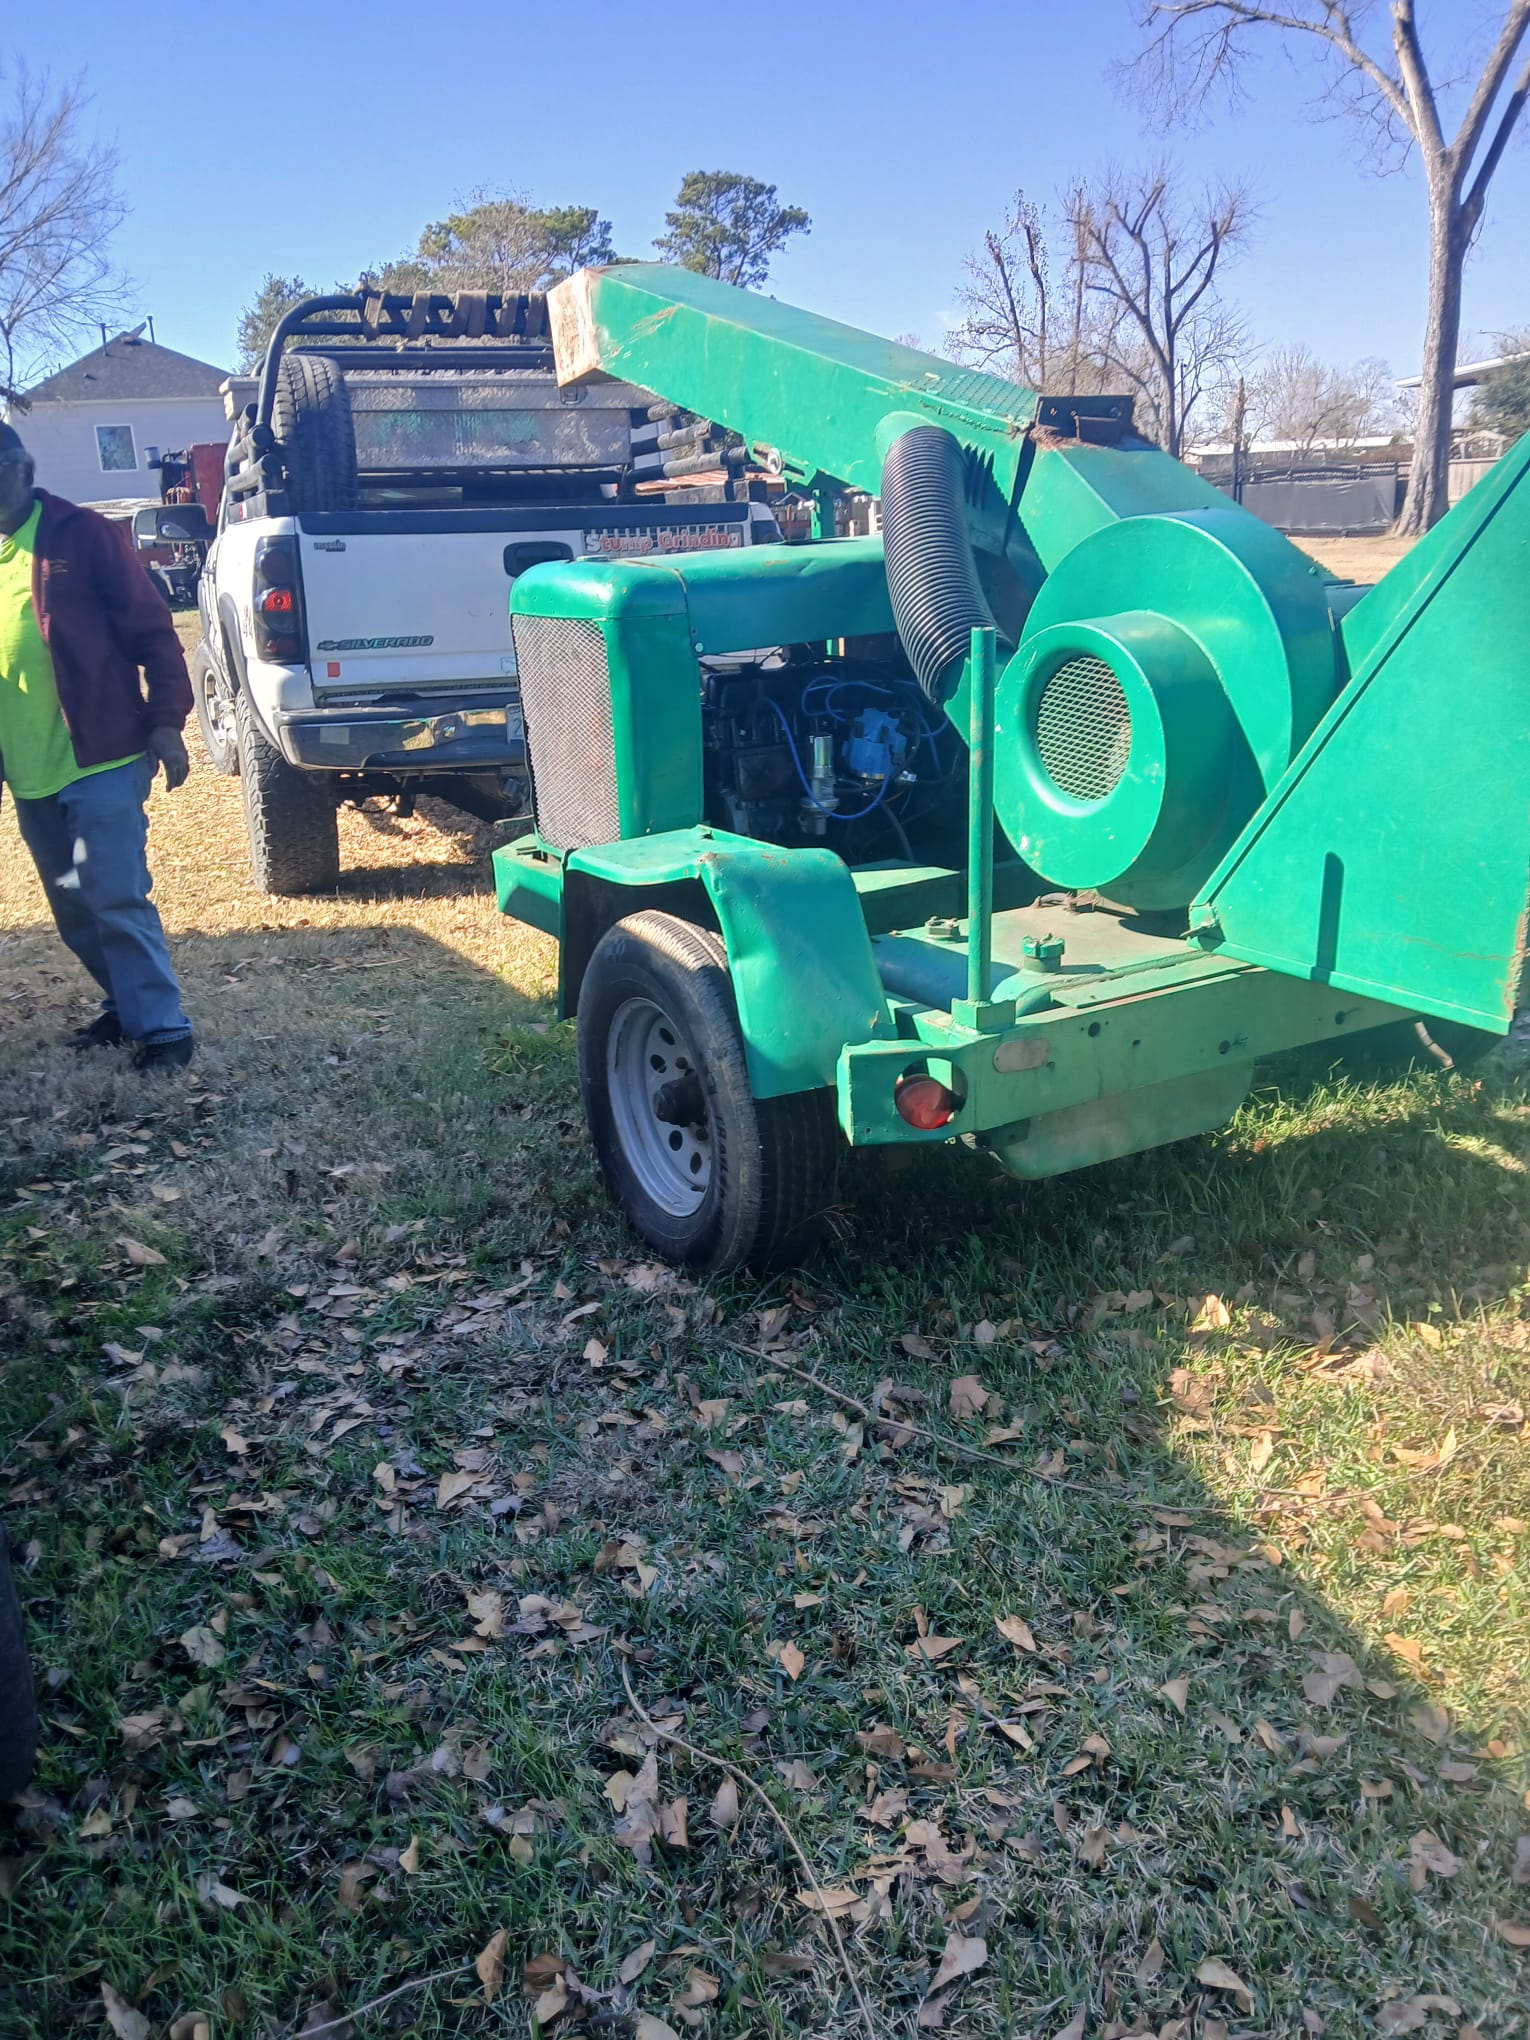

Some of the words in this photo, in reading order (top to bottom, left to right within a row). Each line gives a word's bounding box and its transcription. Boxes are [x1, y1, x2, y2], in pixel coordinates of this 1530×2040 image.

[586, 533, 653, 553] Stump
[658, 527, 741, 550] Grinding
[338, 635, 434, 650] SILVERADO
